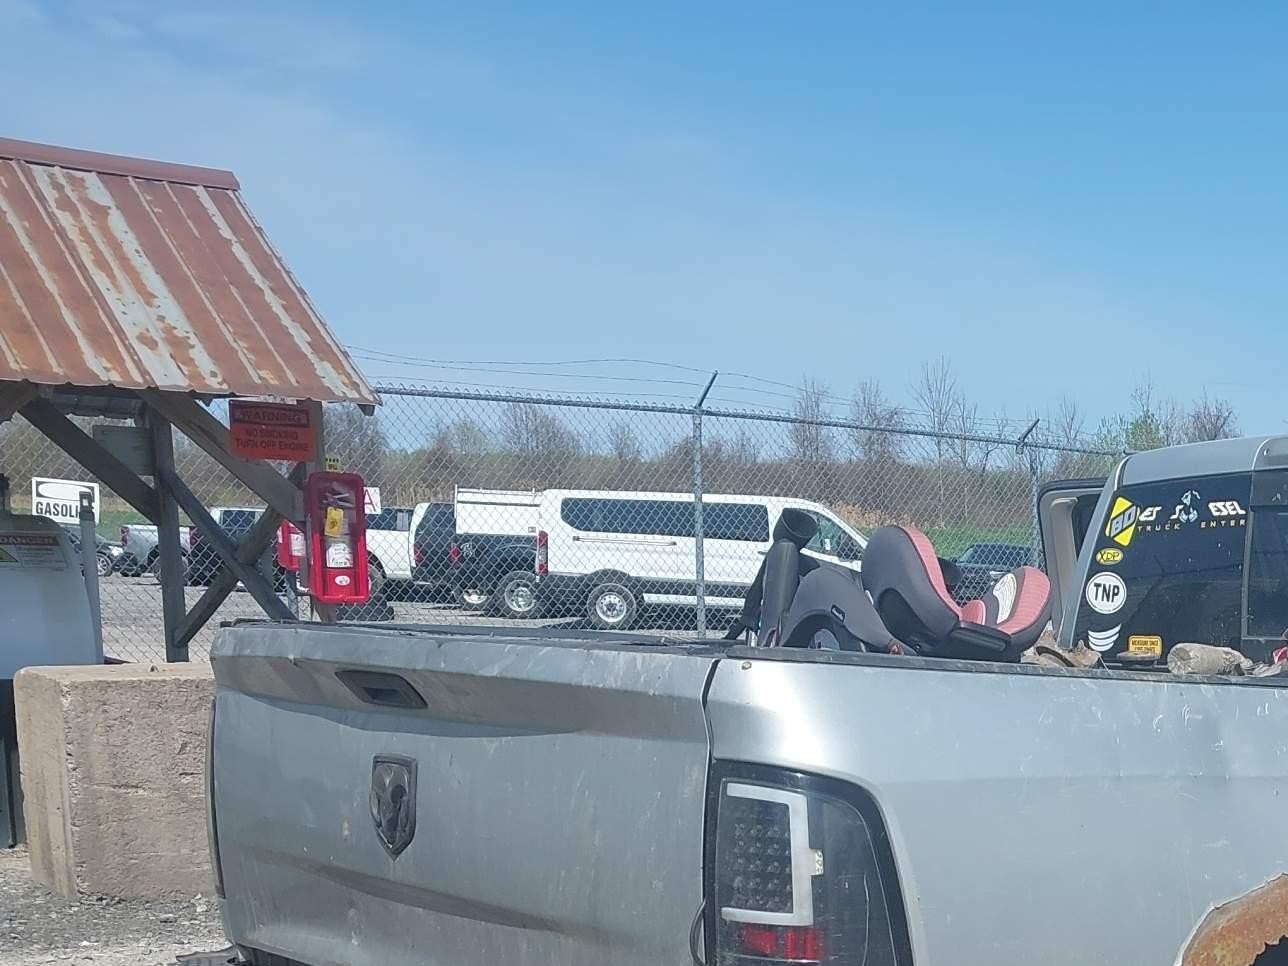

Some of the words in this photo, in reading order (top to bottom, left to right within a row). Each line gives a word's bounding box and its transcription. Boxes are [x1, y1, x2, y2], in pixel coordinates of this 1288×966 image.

[35, 500, 82, 519] GASOLI
[1137, 523, 1181, 533] TRUCK
[1093, 582, 1120, 603] TNP
